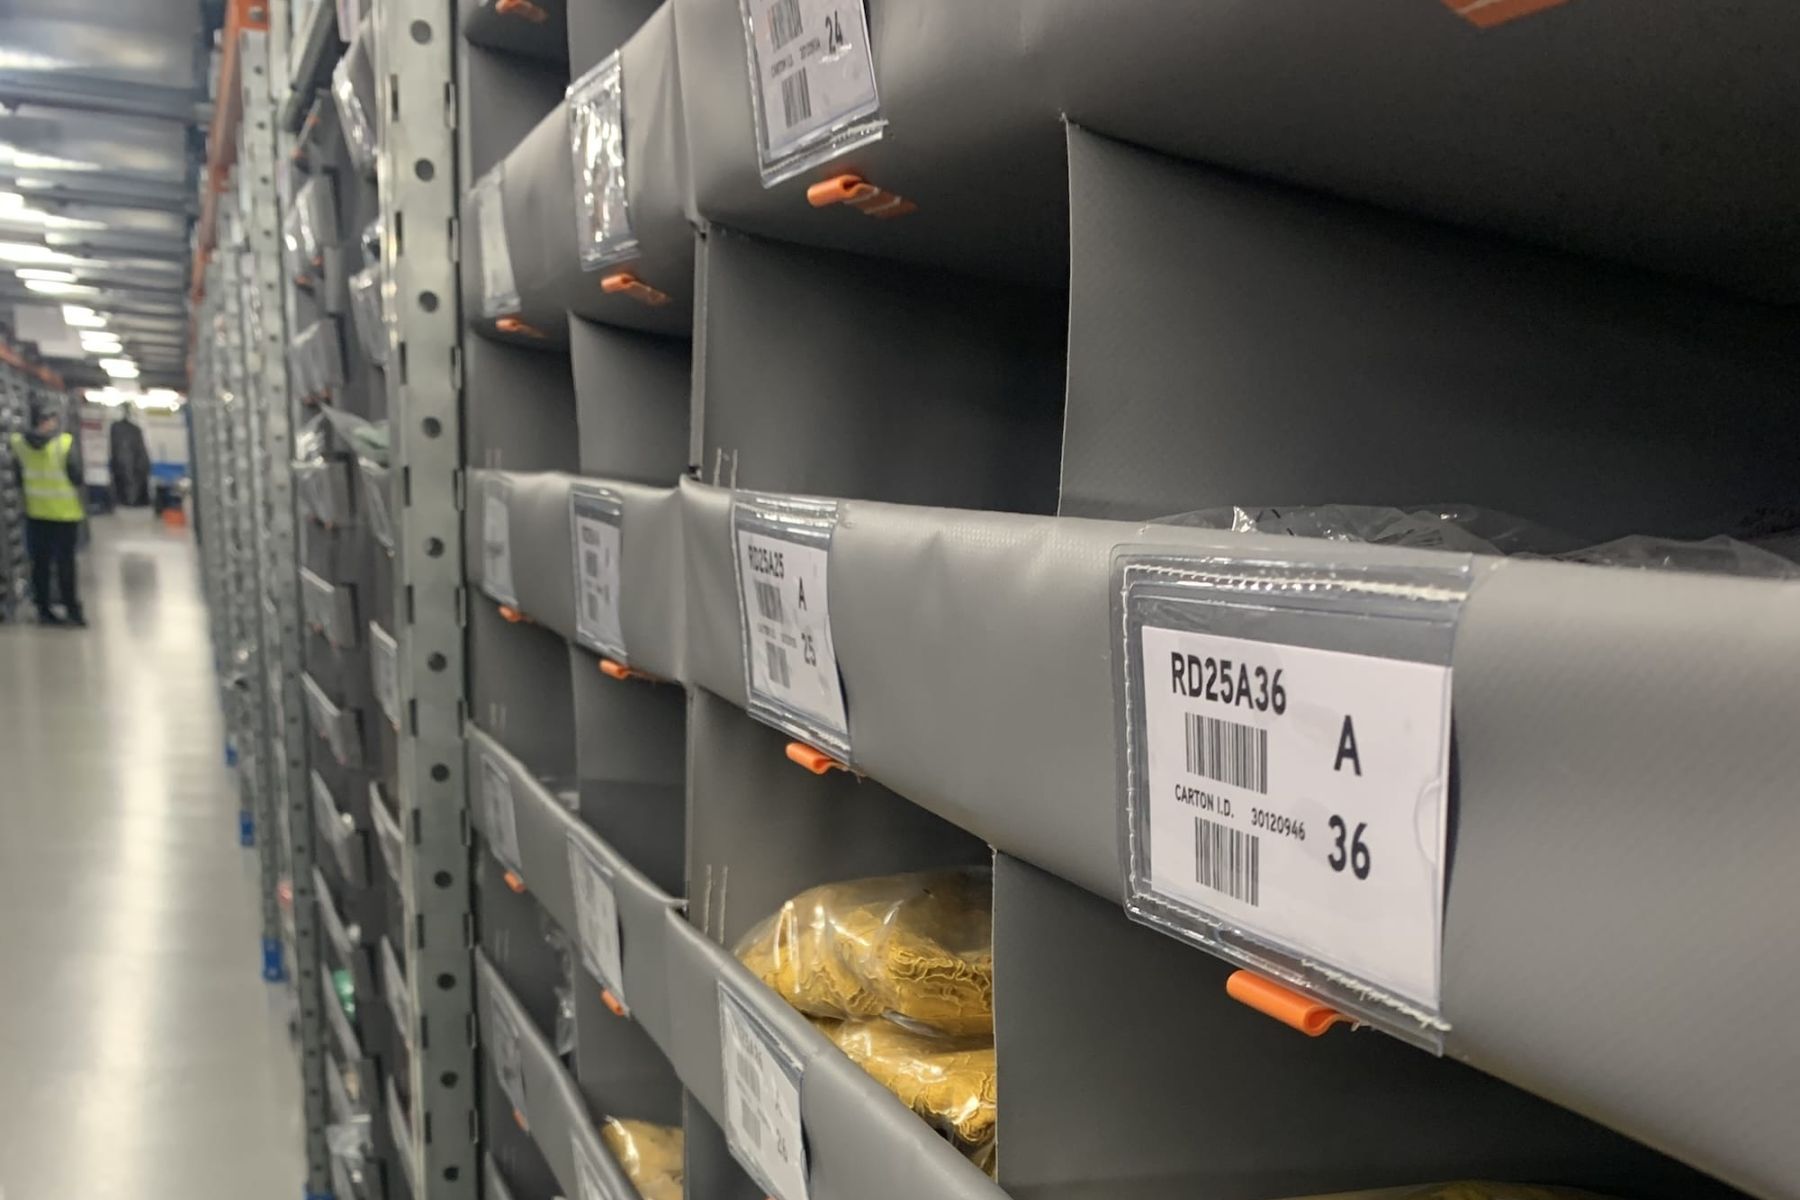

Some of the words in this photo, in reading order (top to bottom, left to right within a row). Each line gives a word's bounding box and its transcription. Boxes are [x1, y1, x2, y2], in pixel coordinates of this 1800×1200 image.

[825, 10, 844, 54] 24
[798, 576, 807, 611] A
[801, 632, 817, 667] 25
[1171, 651, 1287, 716] RD25A36
[1334, 714, 1362, 777] A
[1174, 784, 1215, 812] CARTON
[1217, 796, 1234, 818] I.D.
[1251, 807, 1306, 841] 30120946
[1327, 814, 1371, 880] 36
